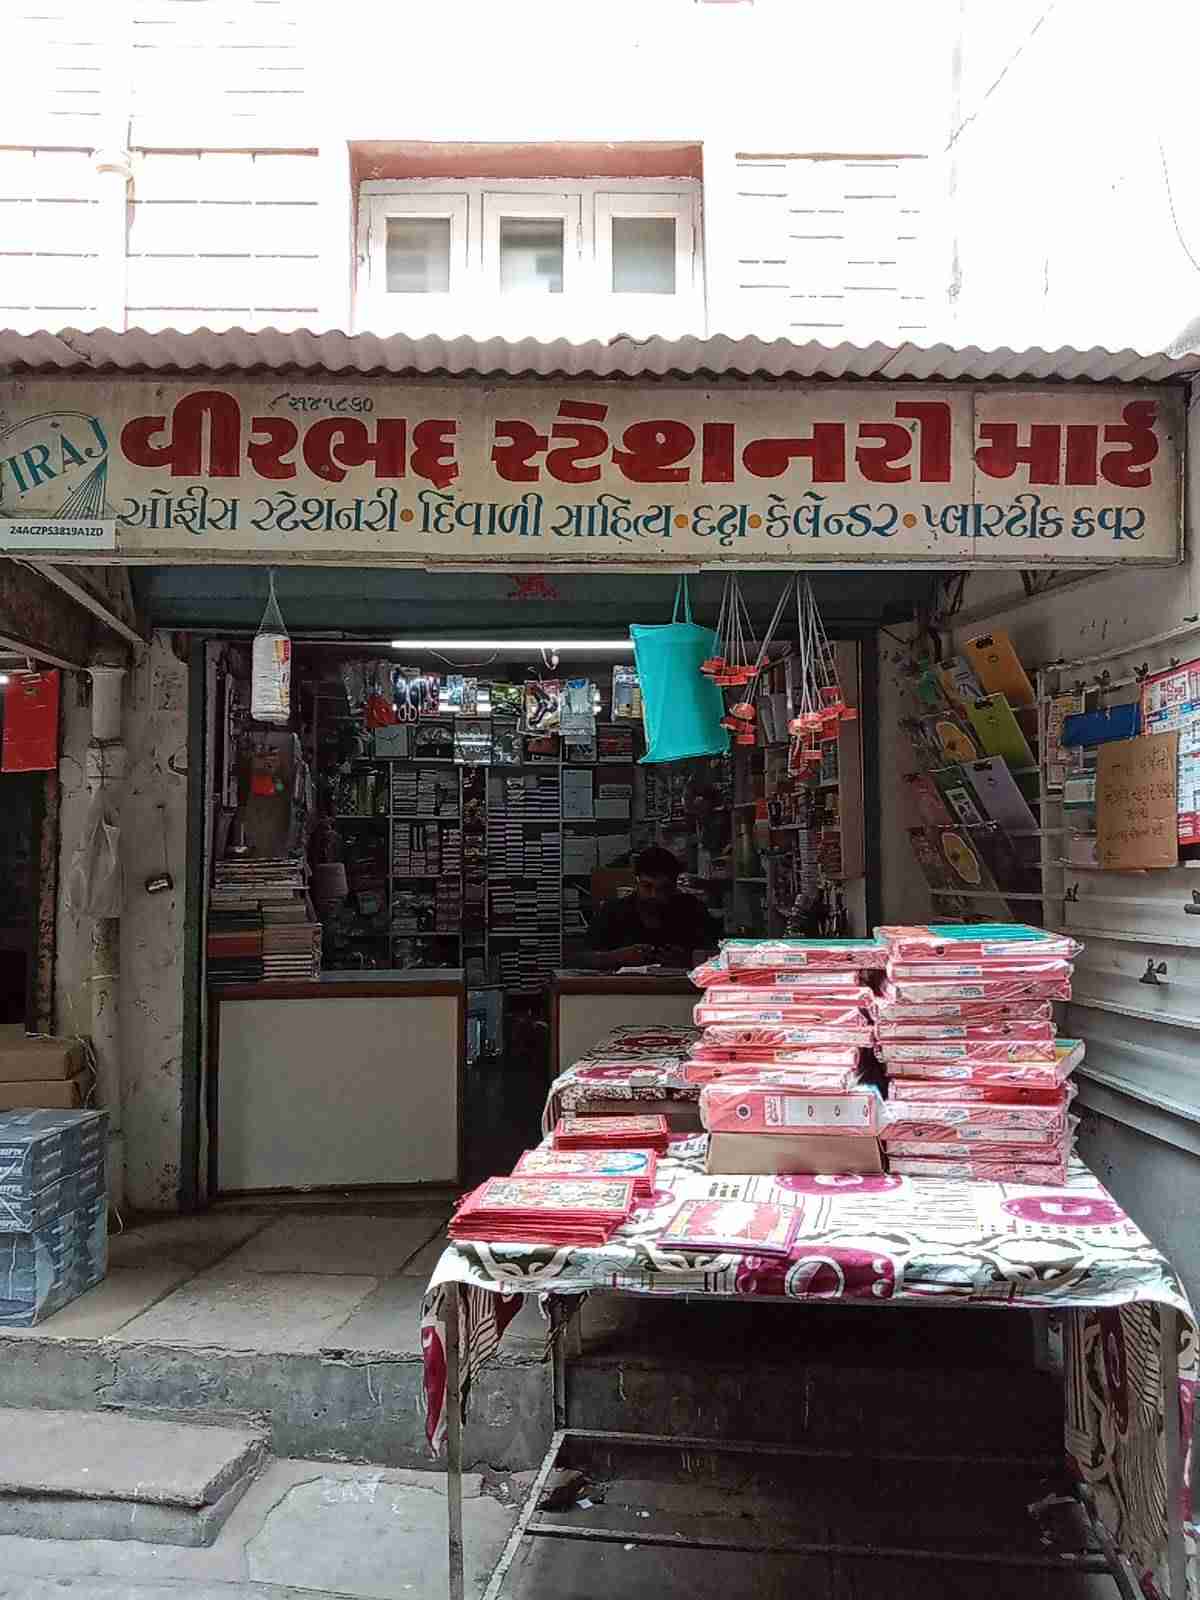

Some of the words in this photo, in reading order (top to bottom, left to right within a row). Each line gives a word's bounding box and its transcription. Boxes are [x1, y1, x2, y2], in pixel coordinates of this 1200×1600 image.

[0, 415, 109, 494] IRAJ
[491, 400, 951, 483] સ્ટેશનરી
[975, 400, 1160, 487] માર્ટ
[250, 487, 399, 532] સ્ટેશનરી
[417, 489, 544, 537] દિવાળી
[550, 493, 674, 542] સાહિત્ય
[1071, 506, 1146, 539] કવર
